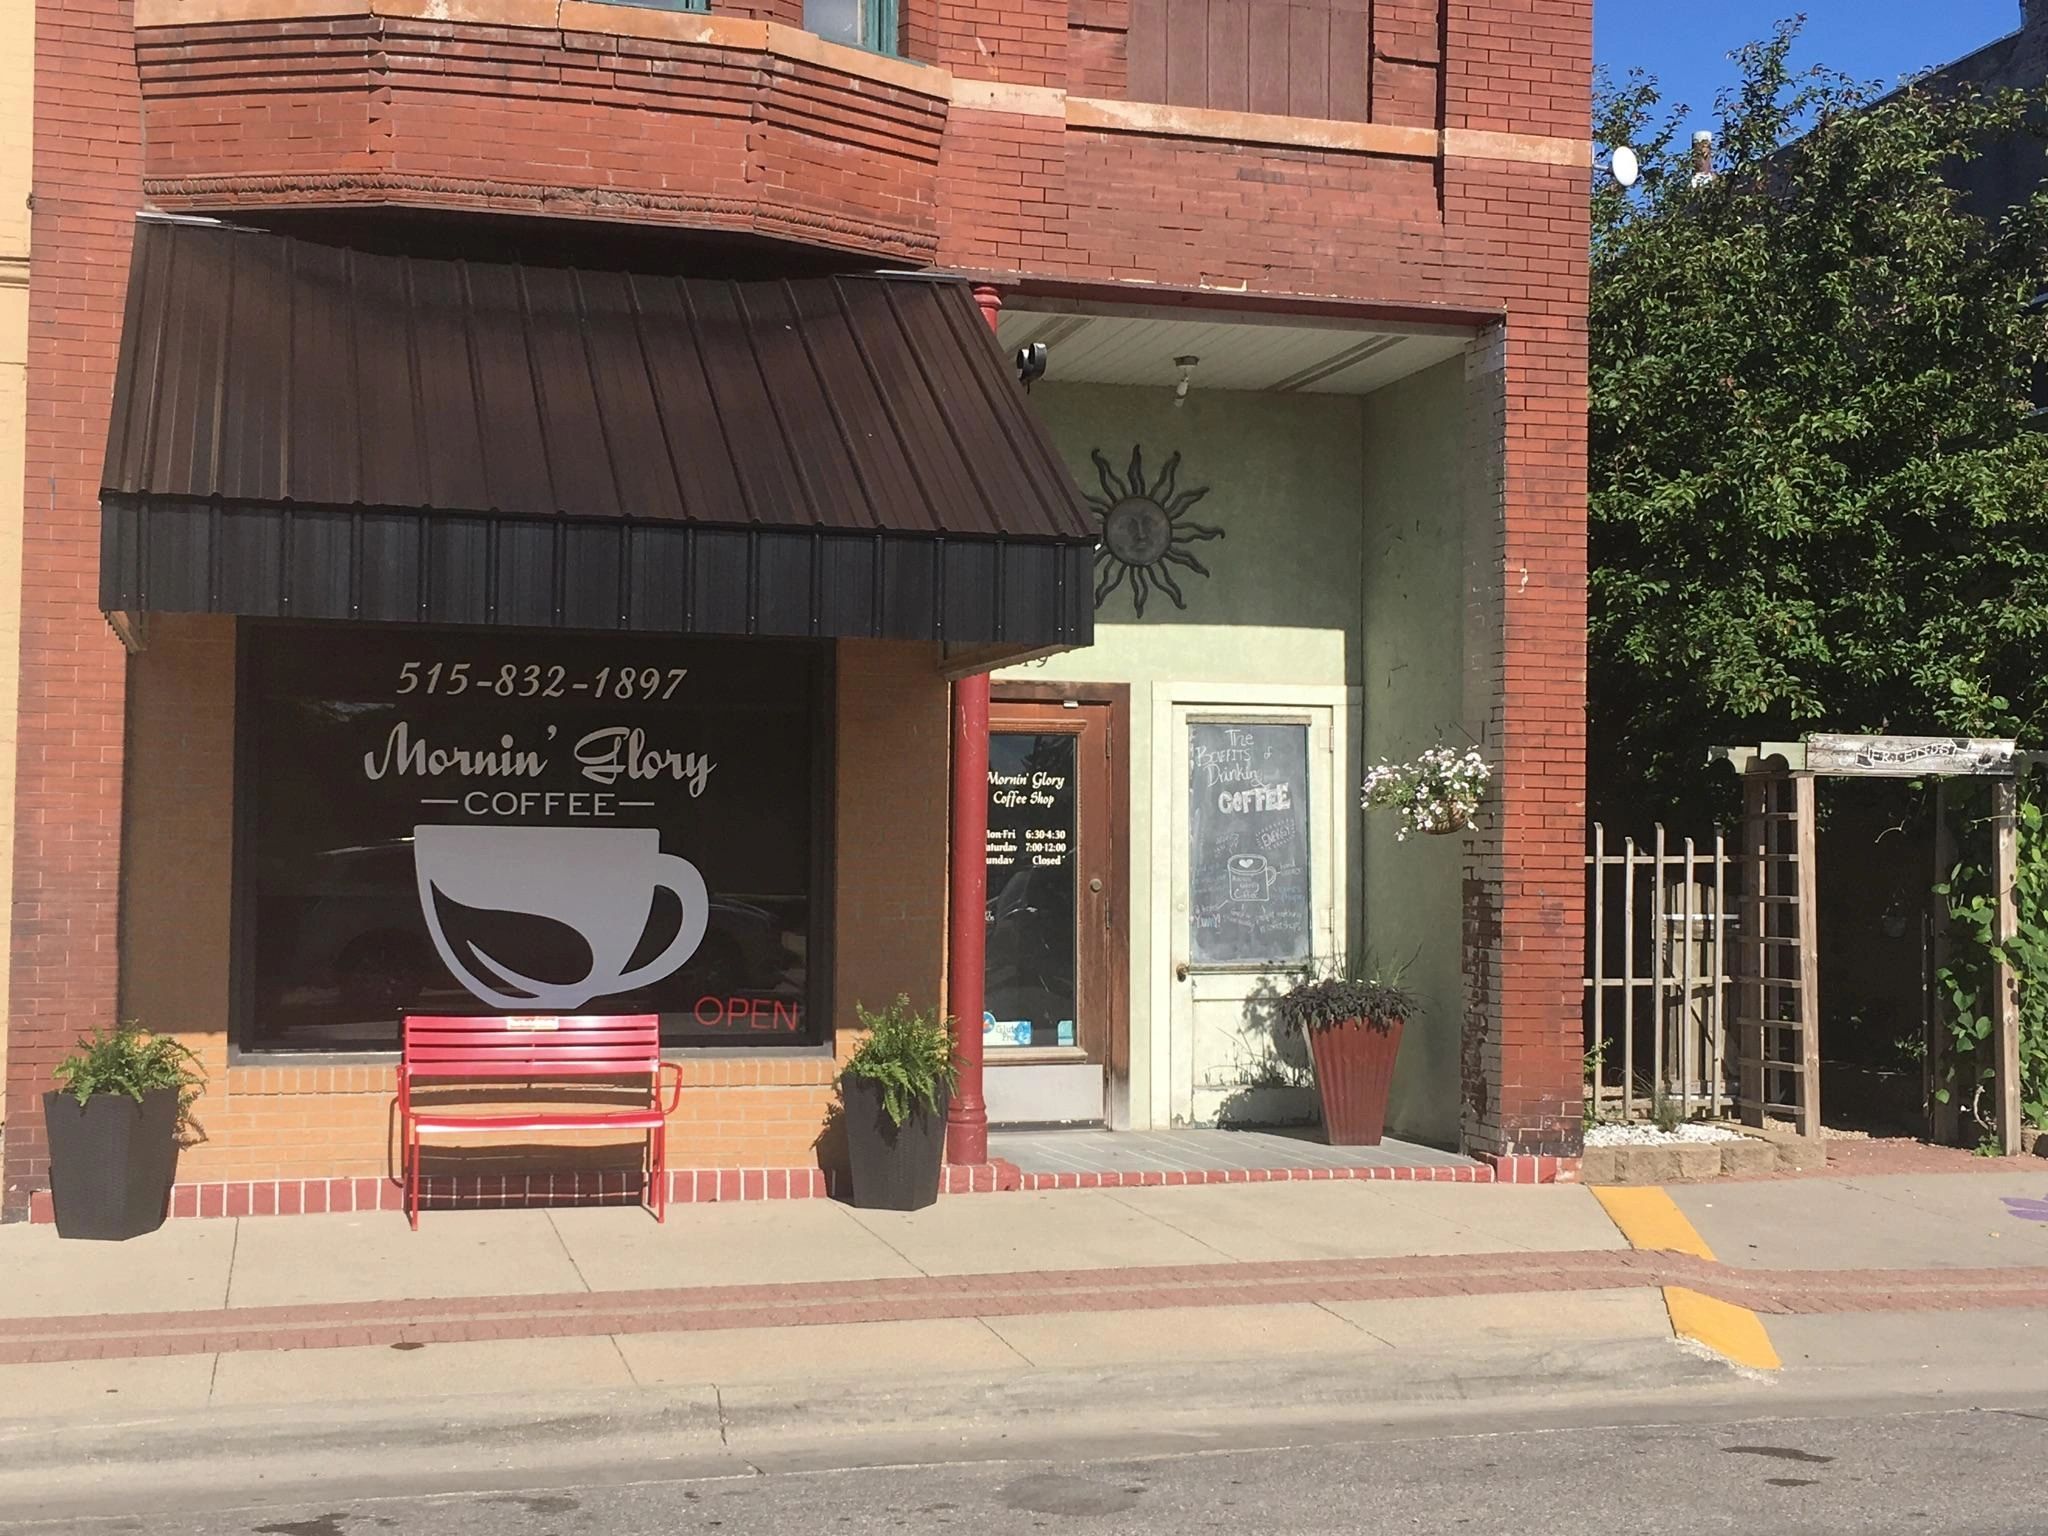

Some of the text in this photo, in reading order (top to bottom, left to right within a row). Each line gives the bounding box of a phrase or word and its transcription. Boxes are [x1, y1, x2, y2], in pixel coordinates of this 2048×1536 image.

[397, 663, 687, 699] 515-832-1897
[1225, 729, 1254, 746] The
[364, 722, 716, 797] Mornin' Glory
[1032, 771, 1065, 789] Glory
[464, 792, 615, 816] COFFEE
[993, 790, 1055, 808] Coffee Shop
[1025, 829, 1066, 839] 6:30-4:30
[985, 841, 1067, 852] aturday 7:00-12:00
[985, 854, 1061, 866] unday Closed
[696, 995, 797, 1031] OPEN
